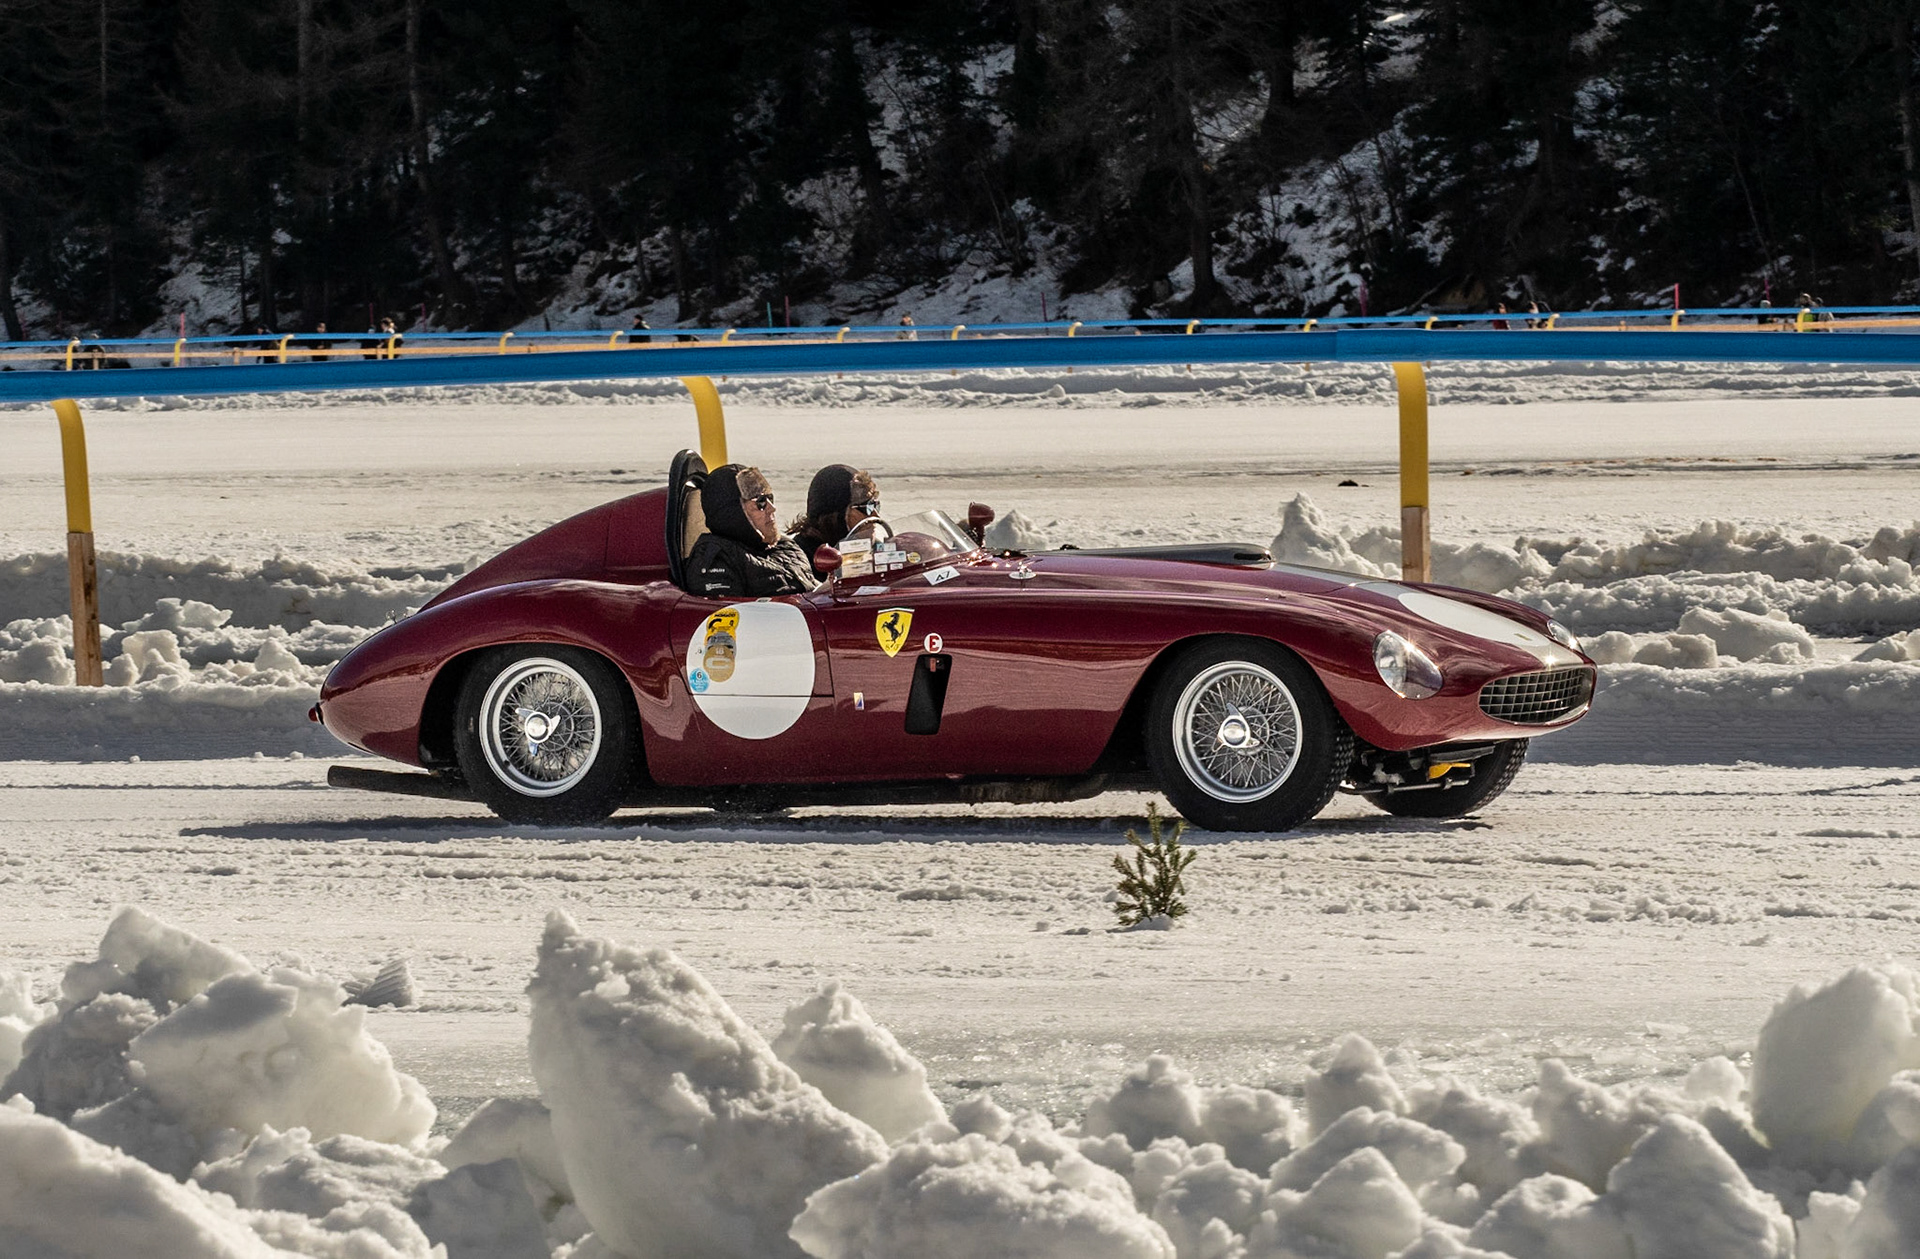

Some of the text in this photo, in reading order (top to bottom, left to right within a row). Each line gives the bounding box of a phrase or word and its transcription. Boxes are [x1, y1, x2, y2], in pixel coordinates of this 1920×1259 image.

[935, 570, 950, 582] A7
[929, 636, 940, 651] E
[696, 671, 702, 679] 6
